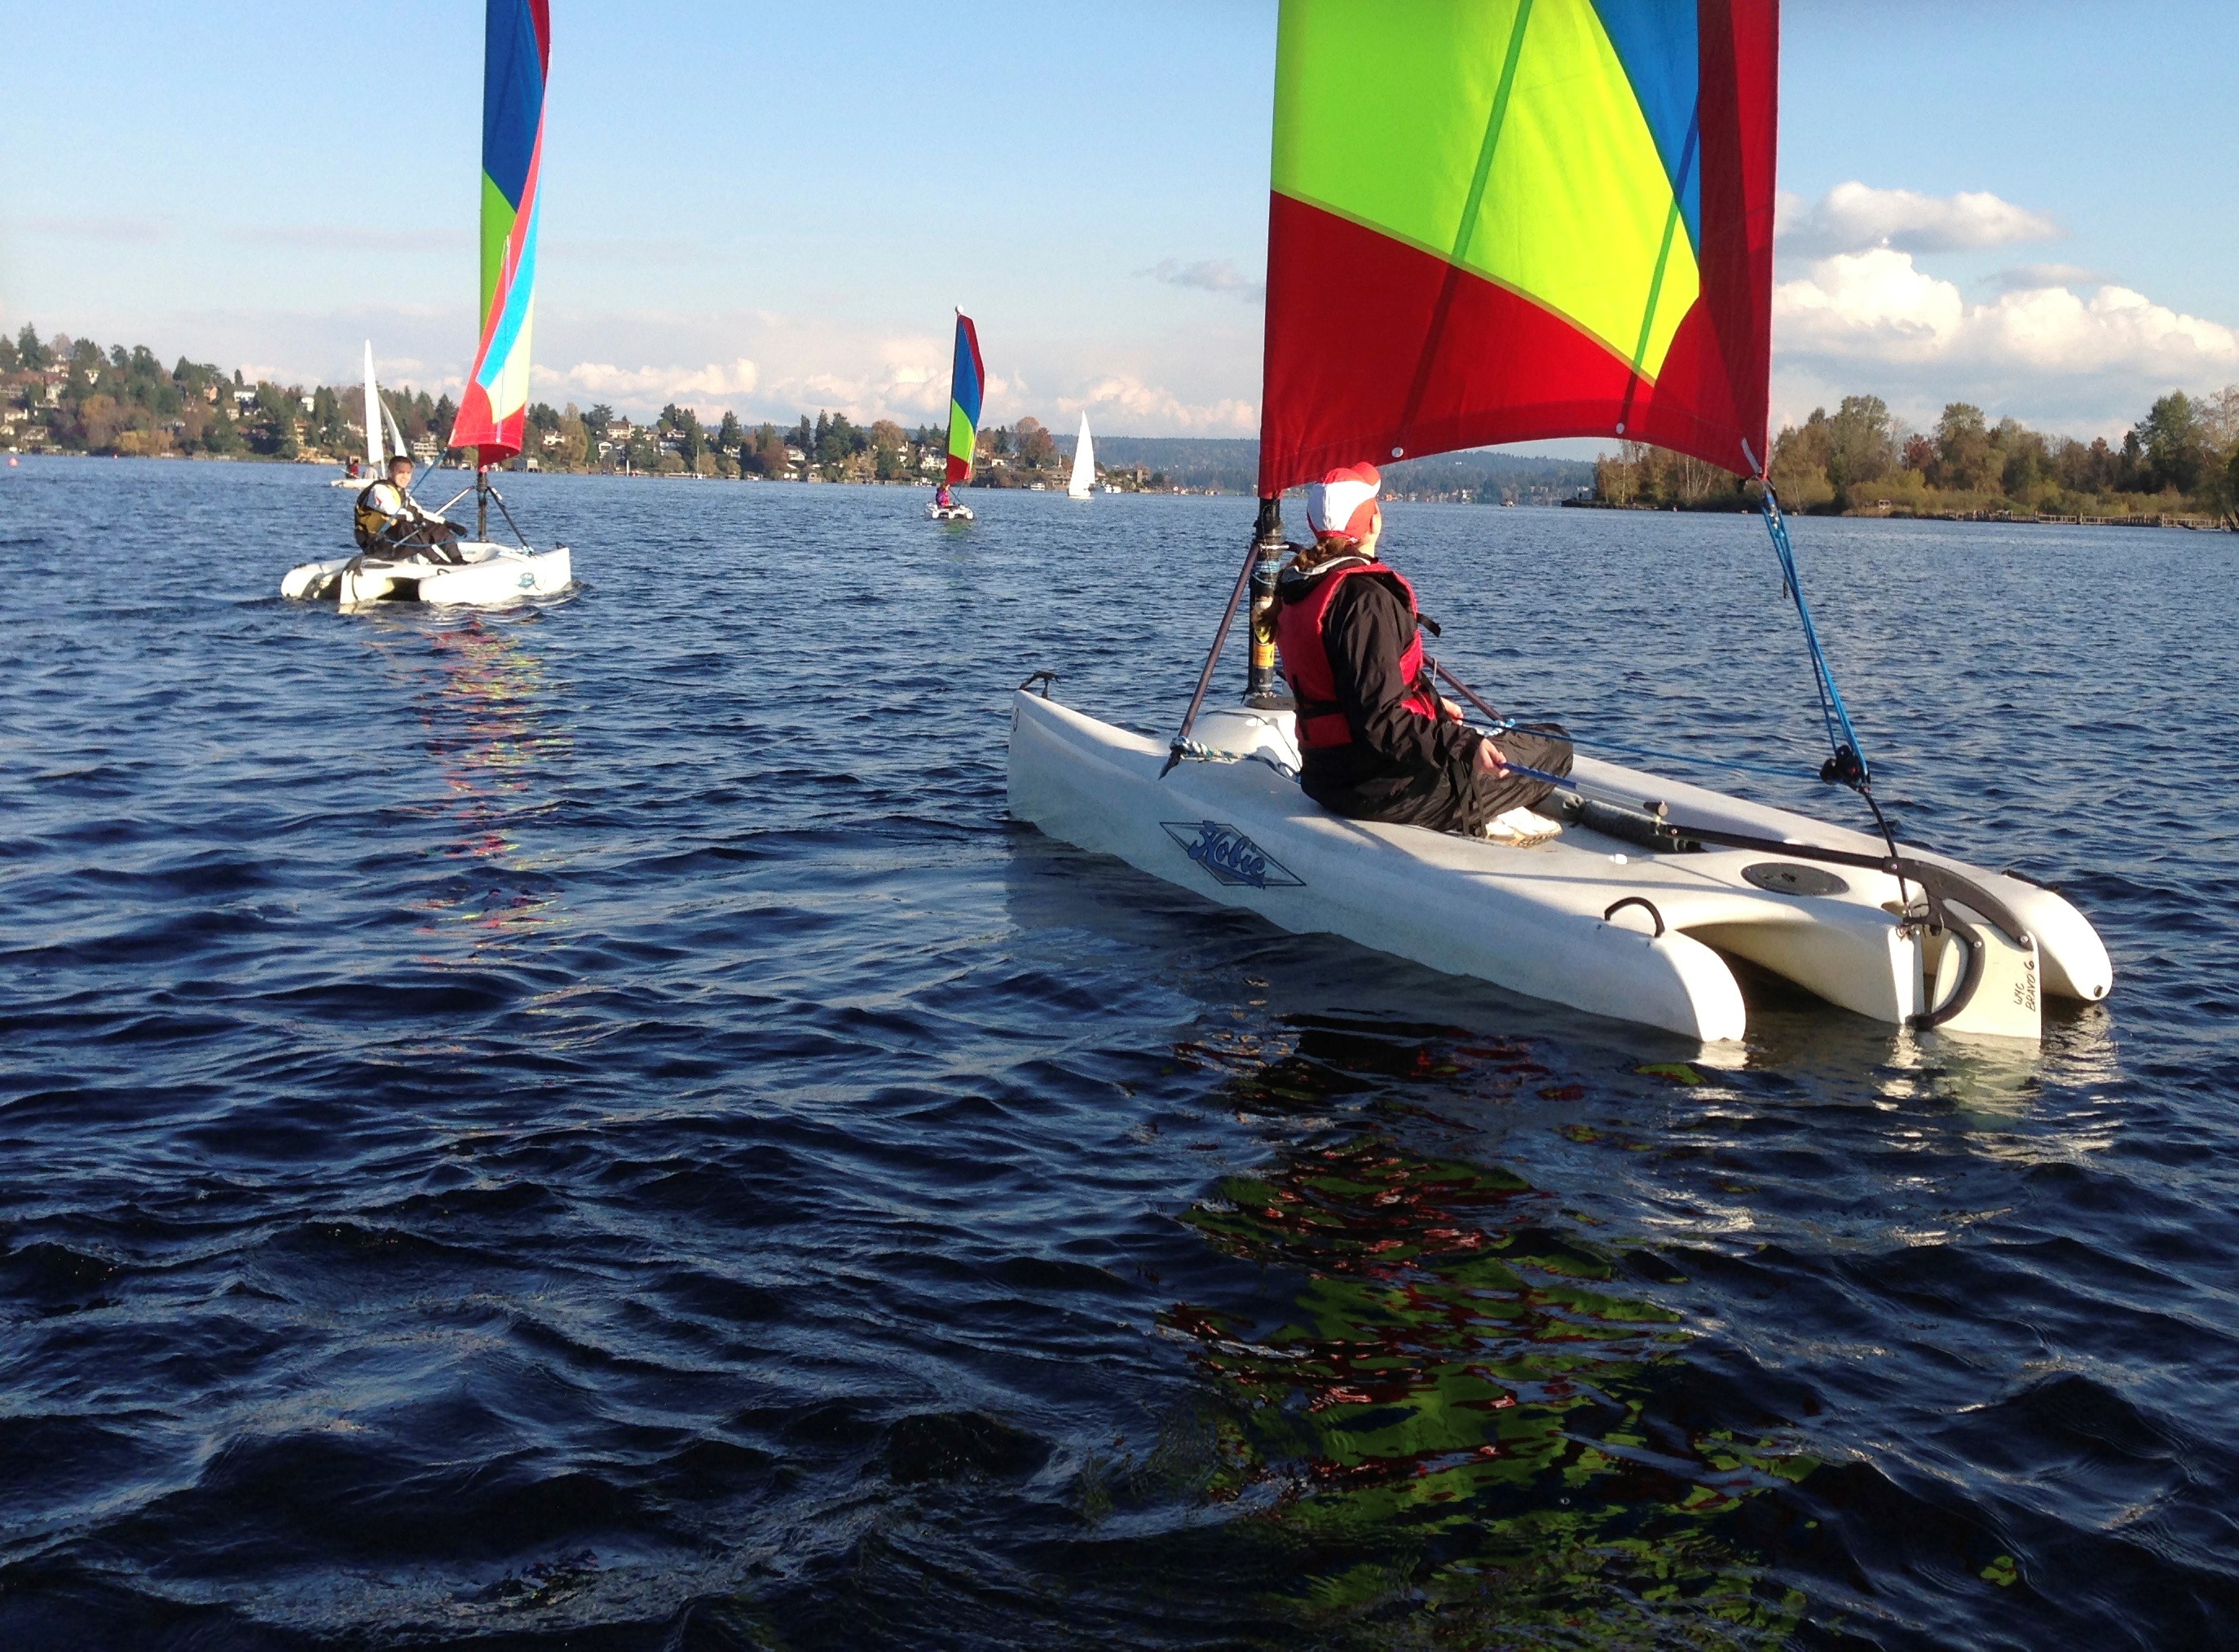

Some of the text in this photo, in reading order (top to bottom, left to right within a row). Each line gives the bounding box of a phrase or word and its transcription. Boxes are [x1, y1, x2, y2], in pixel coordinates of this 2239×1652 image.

[1187, 819, 1266, 890] Hobie
[2013, 983, 2025, 1005] WYC
[2023, 960, 2036, 1012] BRAVO 6
